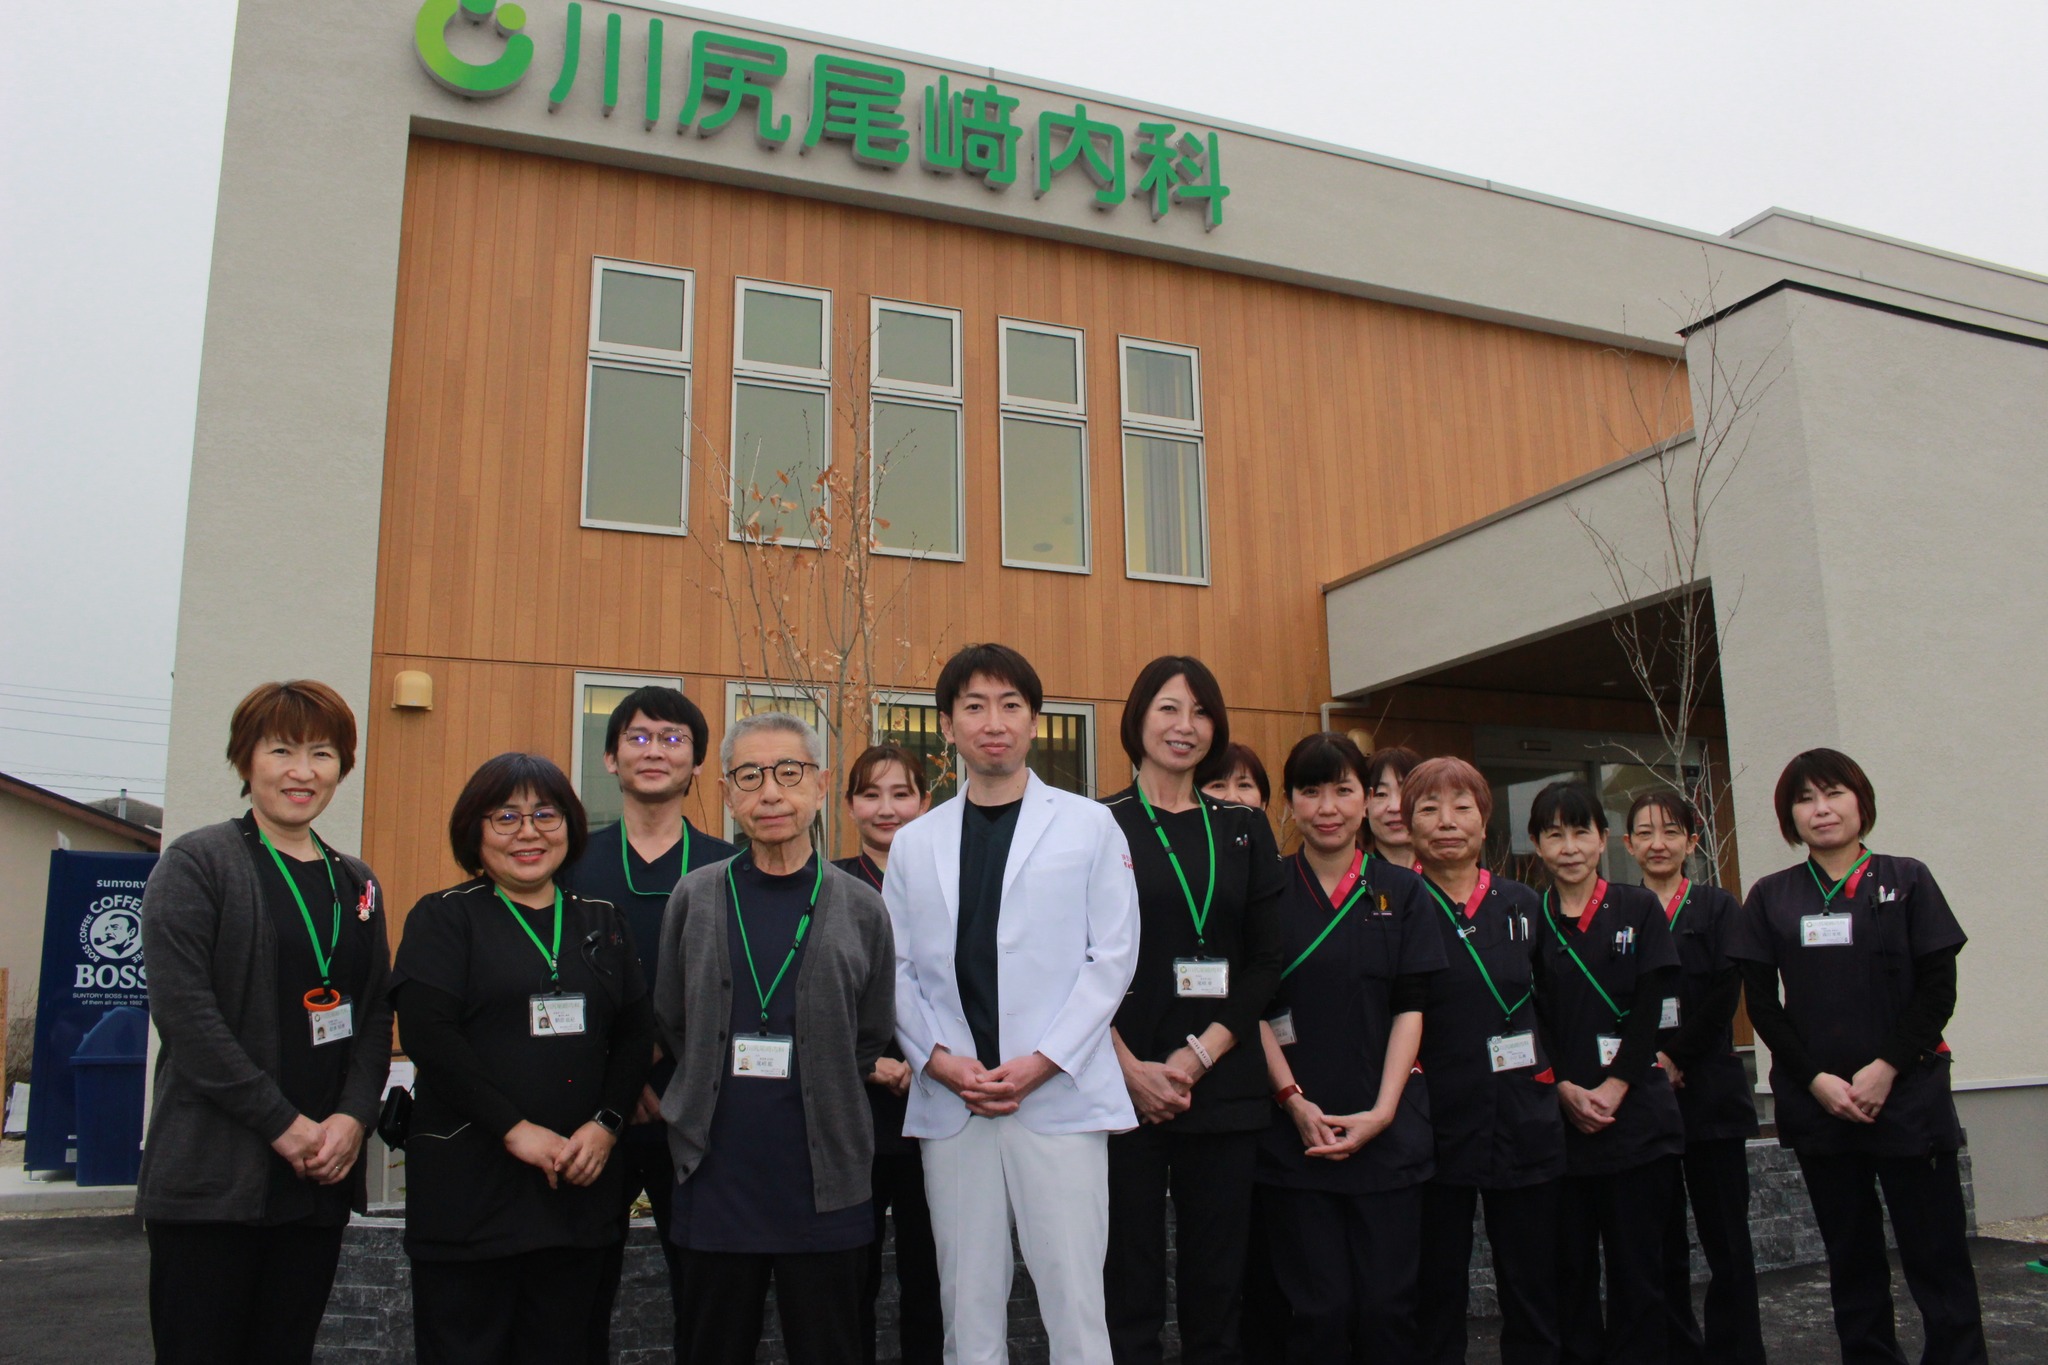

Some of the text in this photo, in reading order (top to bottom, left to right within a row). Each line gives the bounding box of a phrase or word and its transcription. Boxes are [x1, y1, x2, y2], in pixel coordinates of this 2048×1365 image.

[96, 879, 147, 889] SUNTORY
[79, 914, 101, 963] BOSS COFFEE
